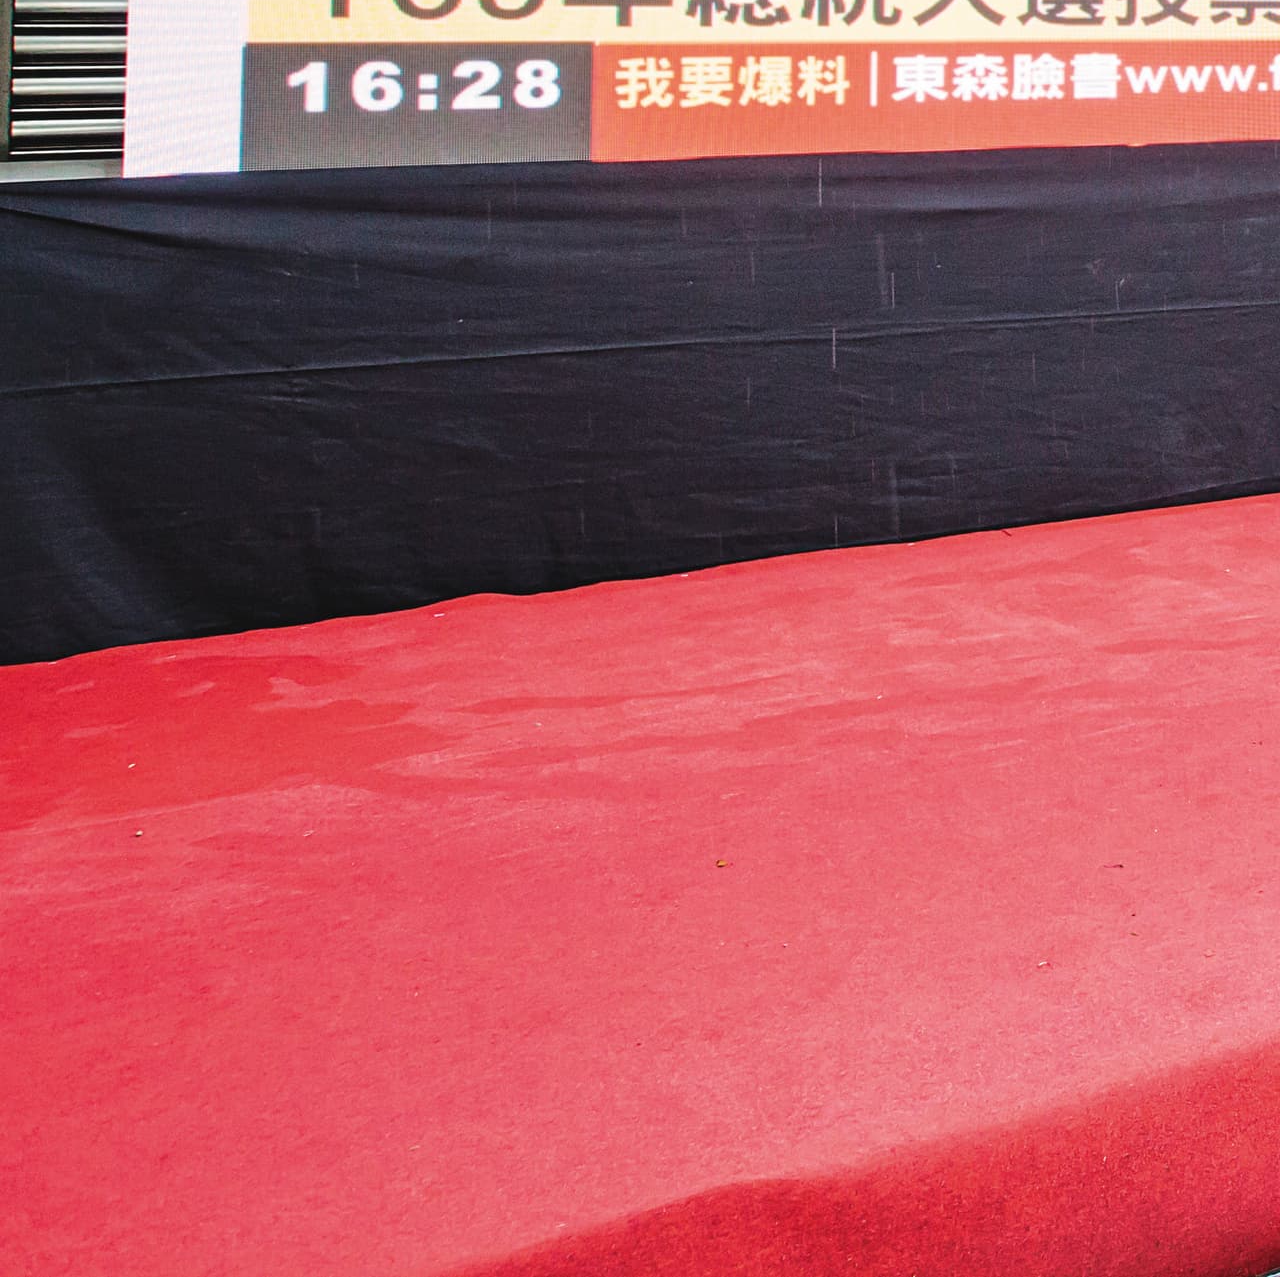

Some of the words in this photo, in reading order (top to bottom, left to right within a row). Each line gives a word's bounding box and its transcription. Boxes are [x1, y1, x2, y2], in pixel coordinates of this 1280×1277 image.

[286, 59, 562, 113] 16:28
[614, 55, 851, 109] 我要爆料
